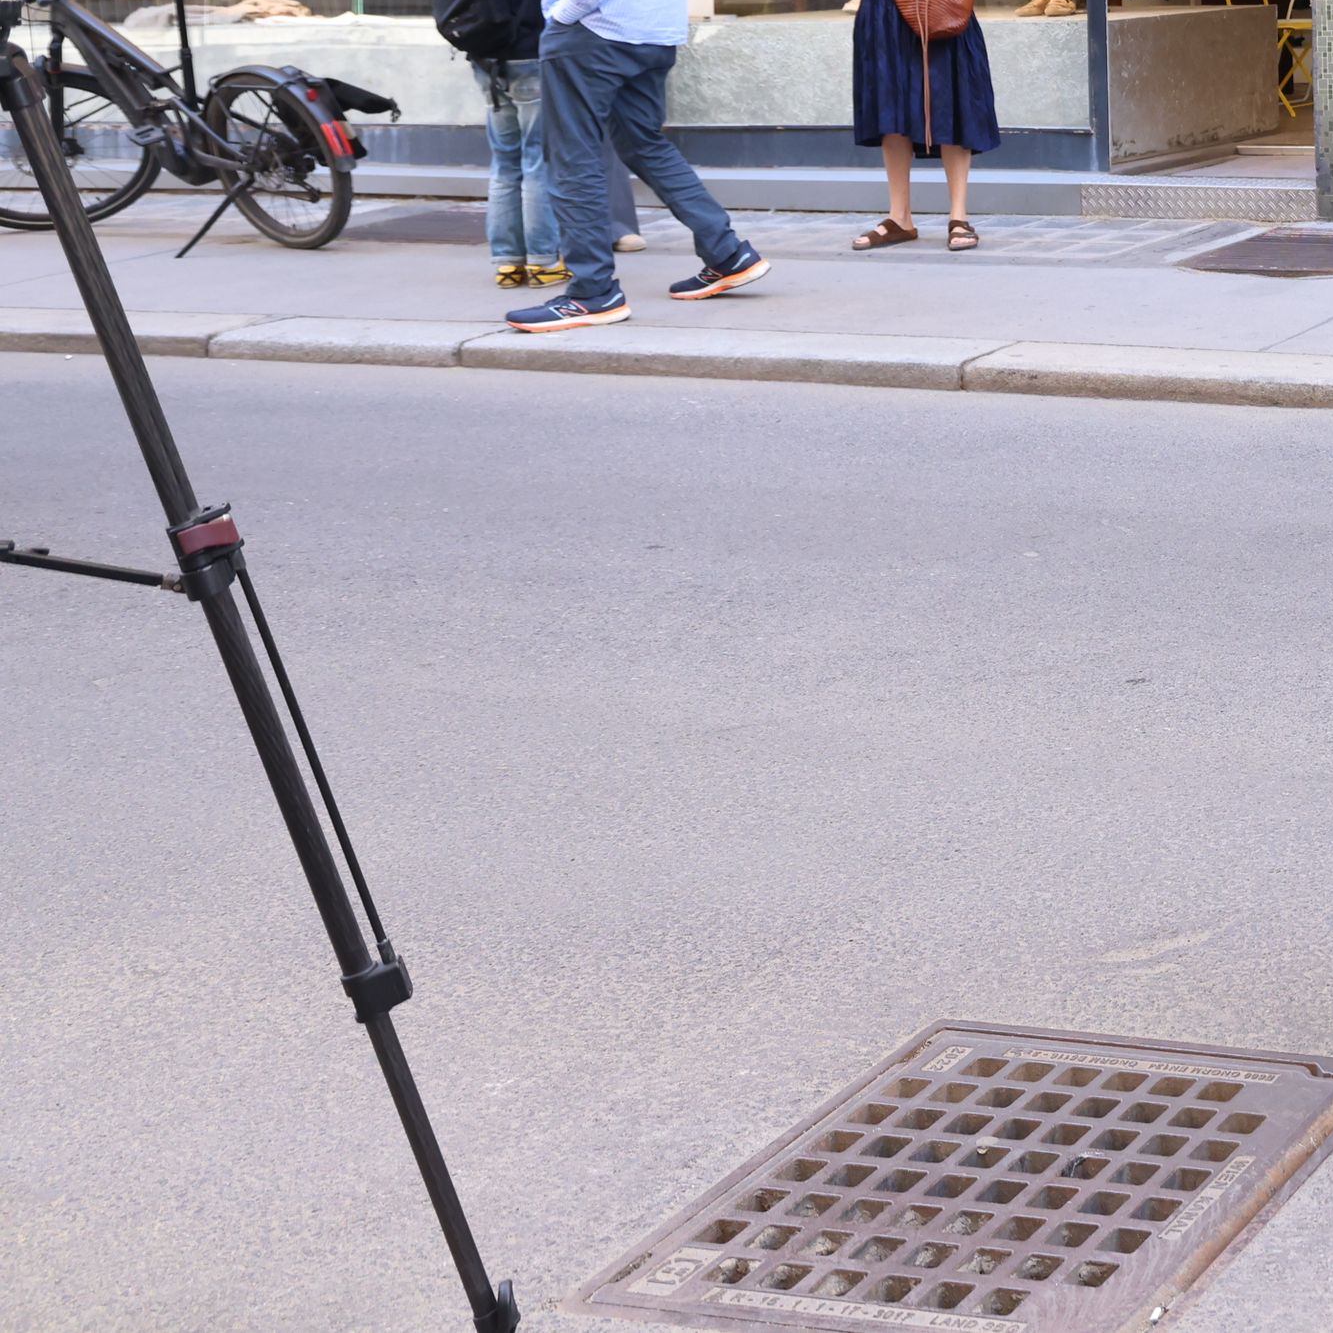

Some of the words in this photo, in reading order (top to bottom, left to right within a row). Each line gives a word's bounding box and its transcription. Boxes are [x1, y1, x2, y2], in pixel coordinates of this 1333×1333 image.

[1210, 1160, 1250, 1189] WIEN
[1164, 1196, 1213, 1235] KANAL
[930, 1315, 978, 1331] LAND
